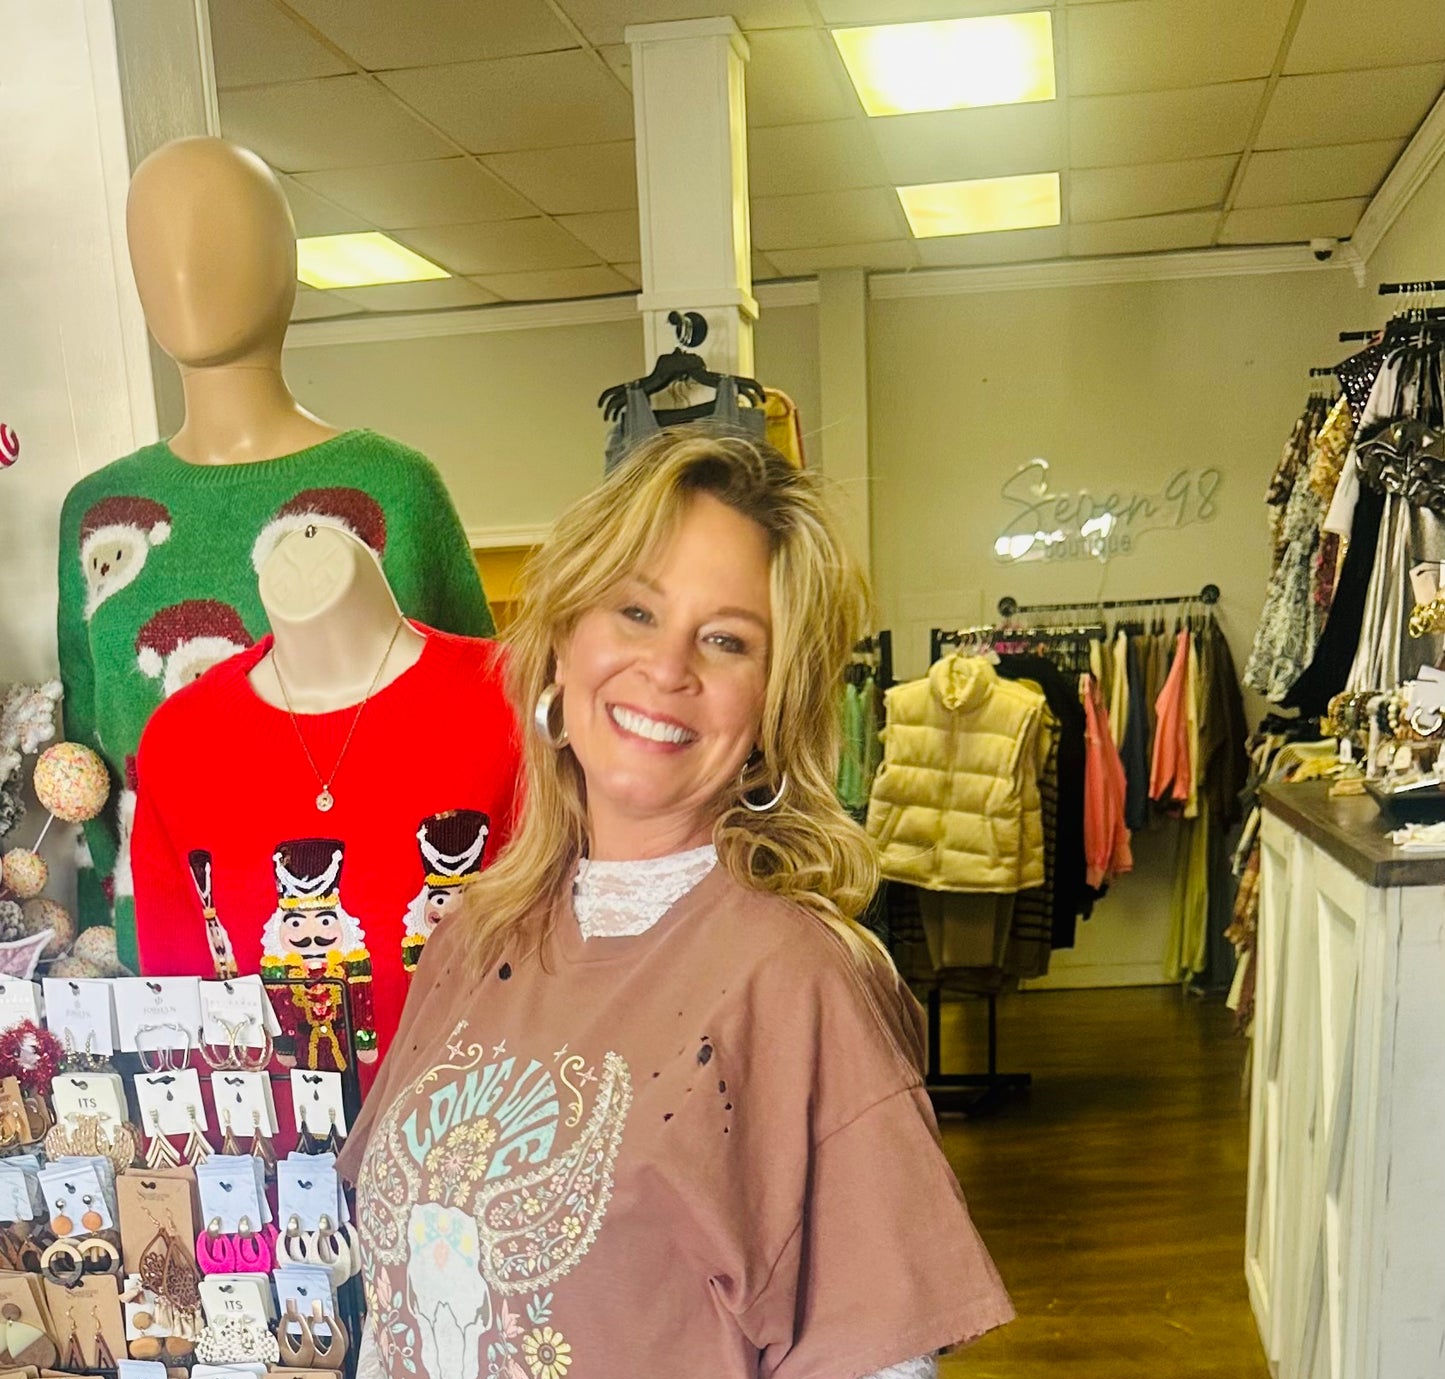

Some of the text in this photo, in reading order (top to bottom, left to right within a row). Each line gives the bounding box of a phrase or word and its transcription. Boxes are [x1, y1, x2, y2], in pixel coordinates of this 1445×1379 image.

[994, 459, 1221, 562] Seven 98
[78, 1097, 98, 1109] ITS
[401, 1057, 560, 1181] LONG LIVE
[224, 1299, 244, 1311] ITS
